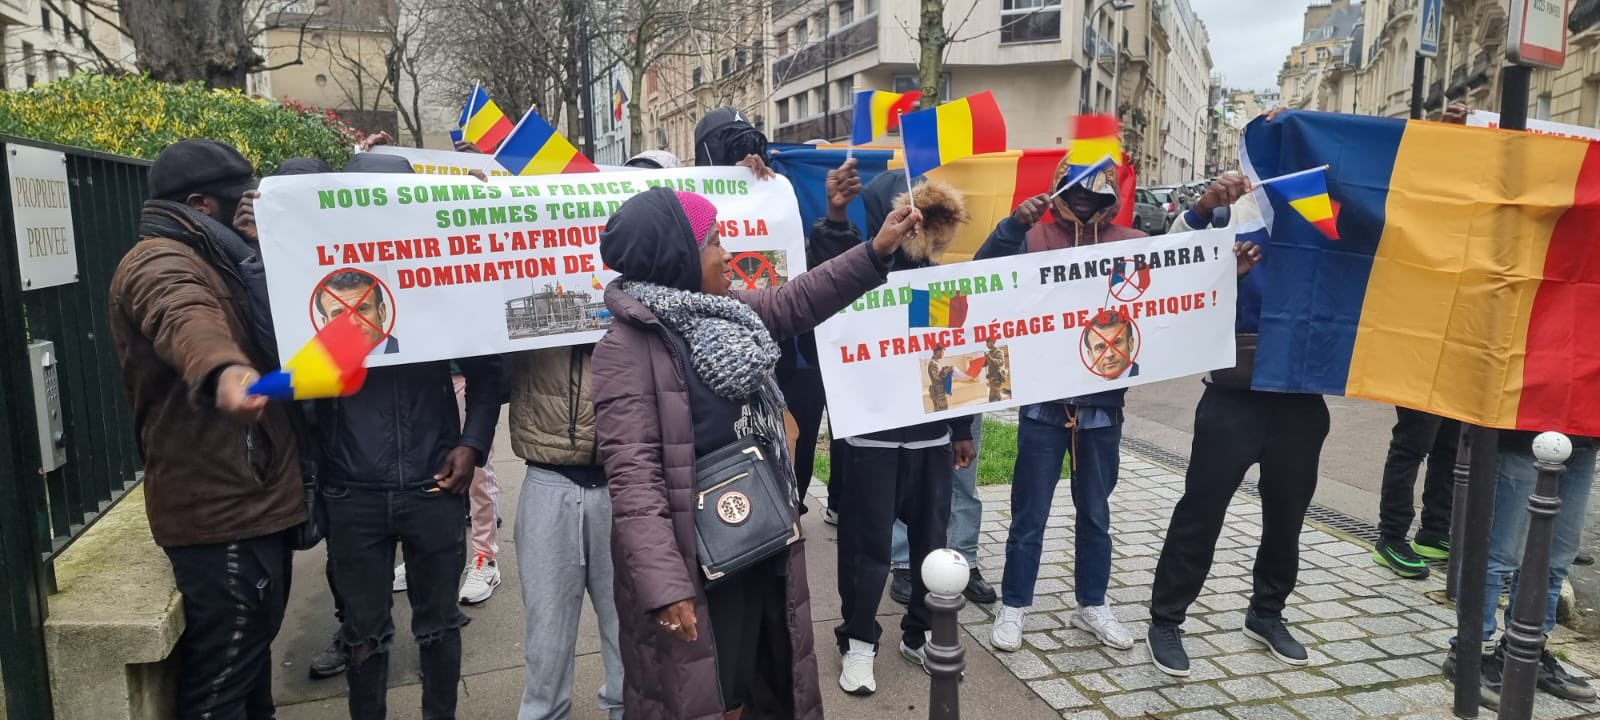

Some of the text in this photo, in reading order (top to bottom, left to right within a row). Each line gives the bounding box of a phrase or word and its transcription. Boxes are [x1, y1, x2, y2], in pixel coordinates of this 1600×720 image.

[15, 177, 68, 208] PROPRIETE
[318, 187, 388, 209] NOUS
[397, 184, 502, 204] SOMMES
[509, 185, 540, 197] EN
[703, 178, 748, 195] NOUS
[435, 200, 623, 228] SOMMES TCHAD
[26, 227, 68, 257] PRIVEE
[316, 237, 441, 266] L'AVENIR
[448, 234, 482, 256] DE
[743, 219, 768, 236] LA
[397, 253, 595, 289] DOMINATION DE
[839, 245, 1219, 314] CHAD HURRA ! FRANCE BARRA !
[840, 290, 1217, 364] LA FRANCE DÉGAGE DE L'AFRIQUE !
